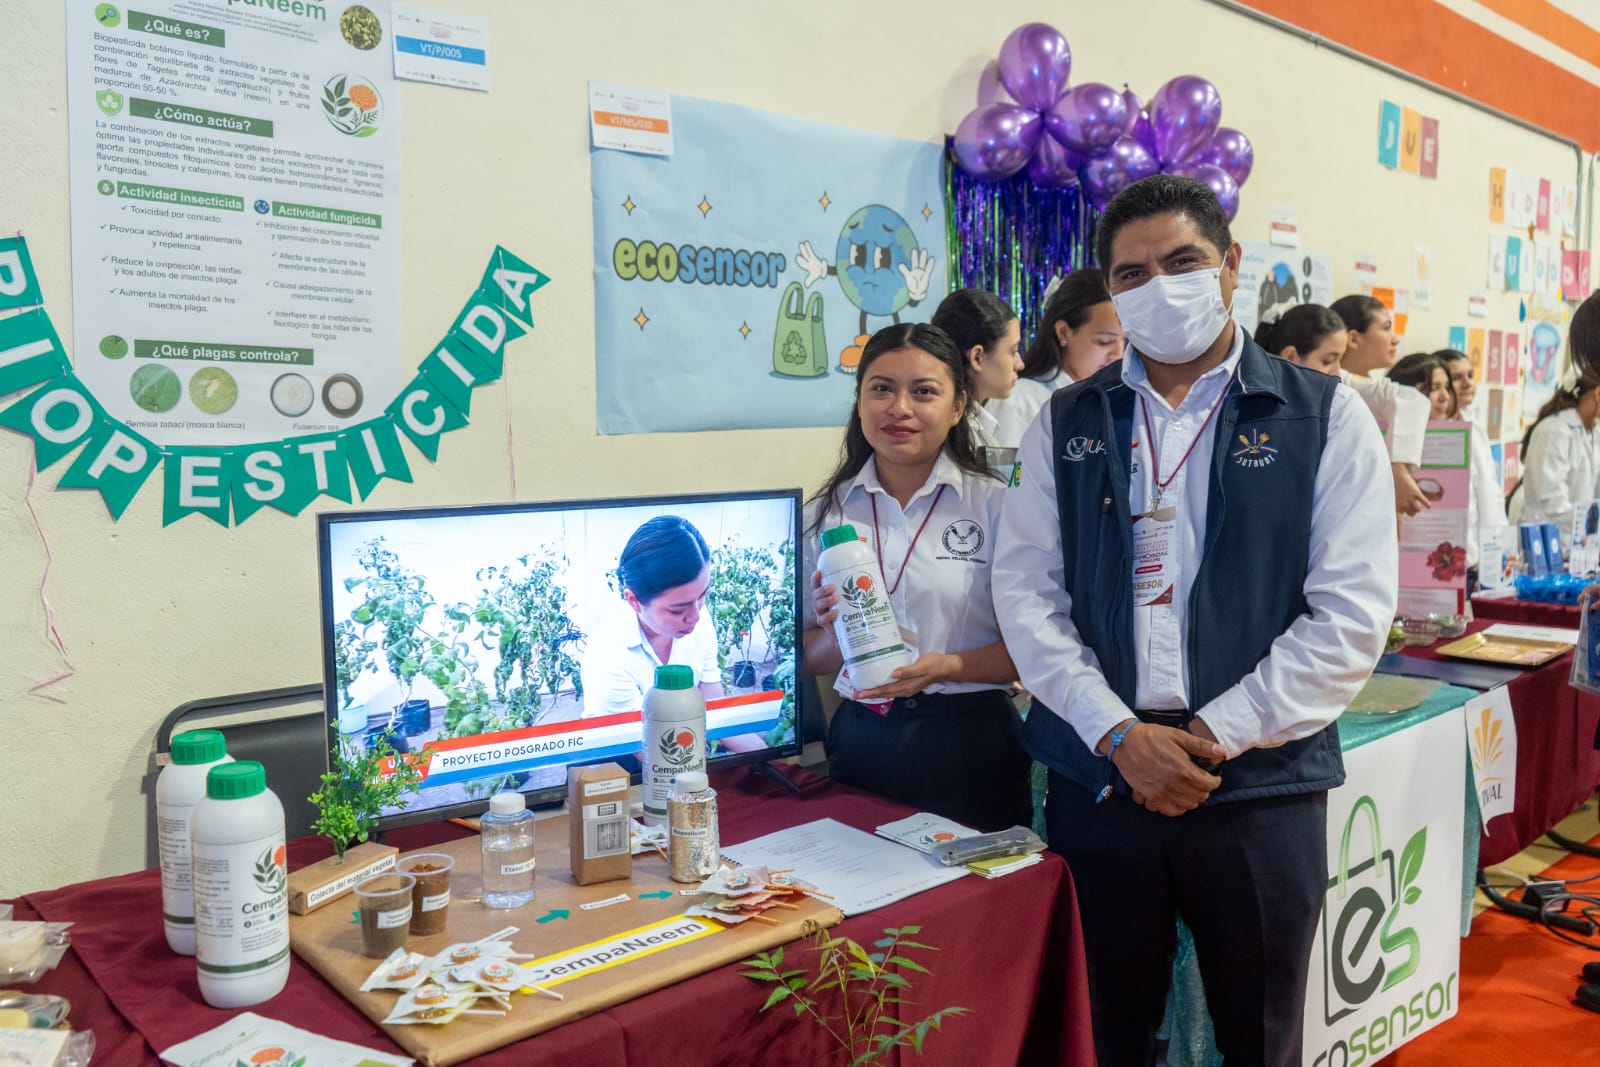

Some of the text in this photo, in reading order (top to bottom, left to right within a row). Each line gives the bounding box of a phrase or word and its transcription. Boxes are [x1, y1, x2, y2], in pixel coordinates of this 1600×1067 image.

[144, 19, 182, 35] ¿Qué
[185, 28, 210, 41] es?
[420, 42, 463, 59] VT/P/005
[94, 76, 167, 95] proporción 50-50
[154, 106, 251, 131] ¿Cómo actúa?
[1385, 120, 1434, 162] JUE
[120, 185, 242, 210] Actividad insecticida
[130, 205, 223, 224] Toxicidad por contacto.
[278, 205, 376, 226] Actividad fungicida
[613, 238, 786, 288] ecosensor
[152, 344, 299, 363] ¿Qué plagas controla?
[125, 419, 245, 430] Bemisia tabaci (mosca blanca)
[442, 737, 585, 768] PROYECTO POSGRADO FIC
[310, 857, 393, 902] Colecta del material vegetal
[505, 865, 524, 873] Etanol
